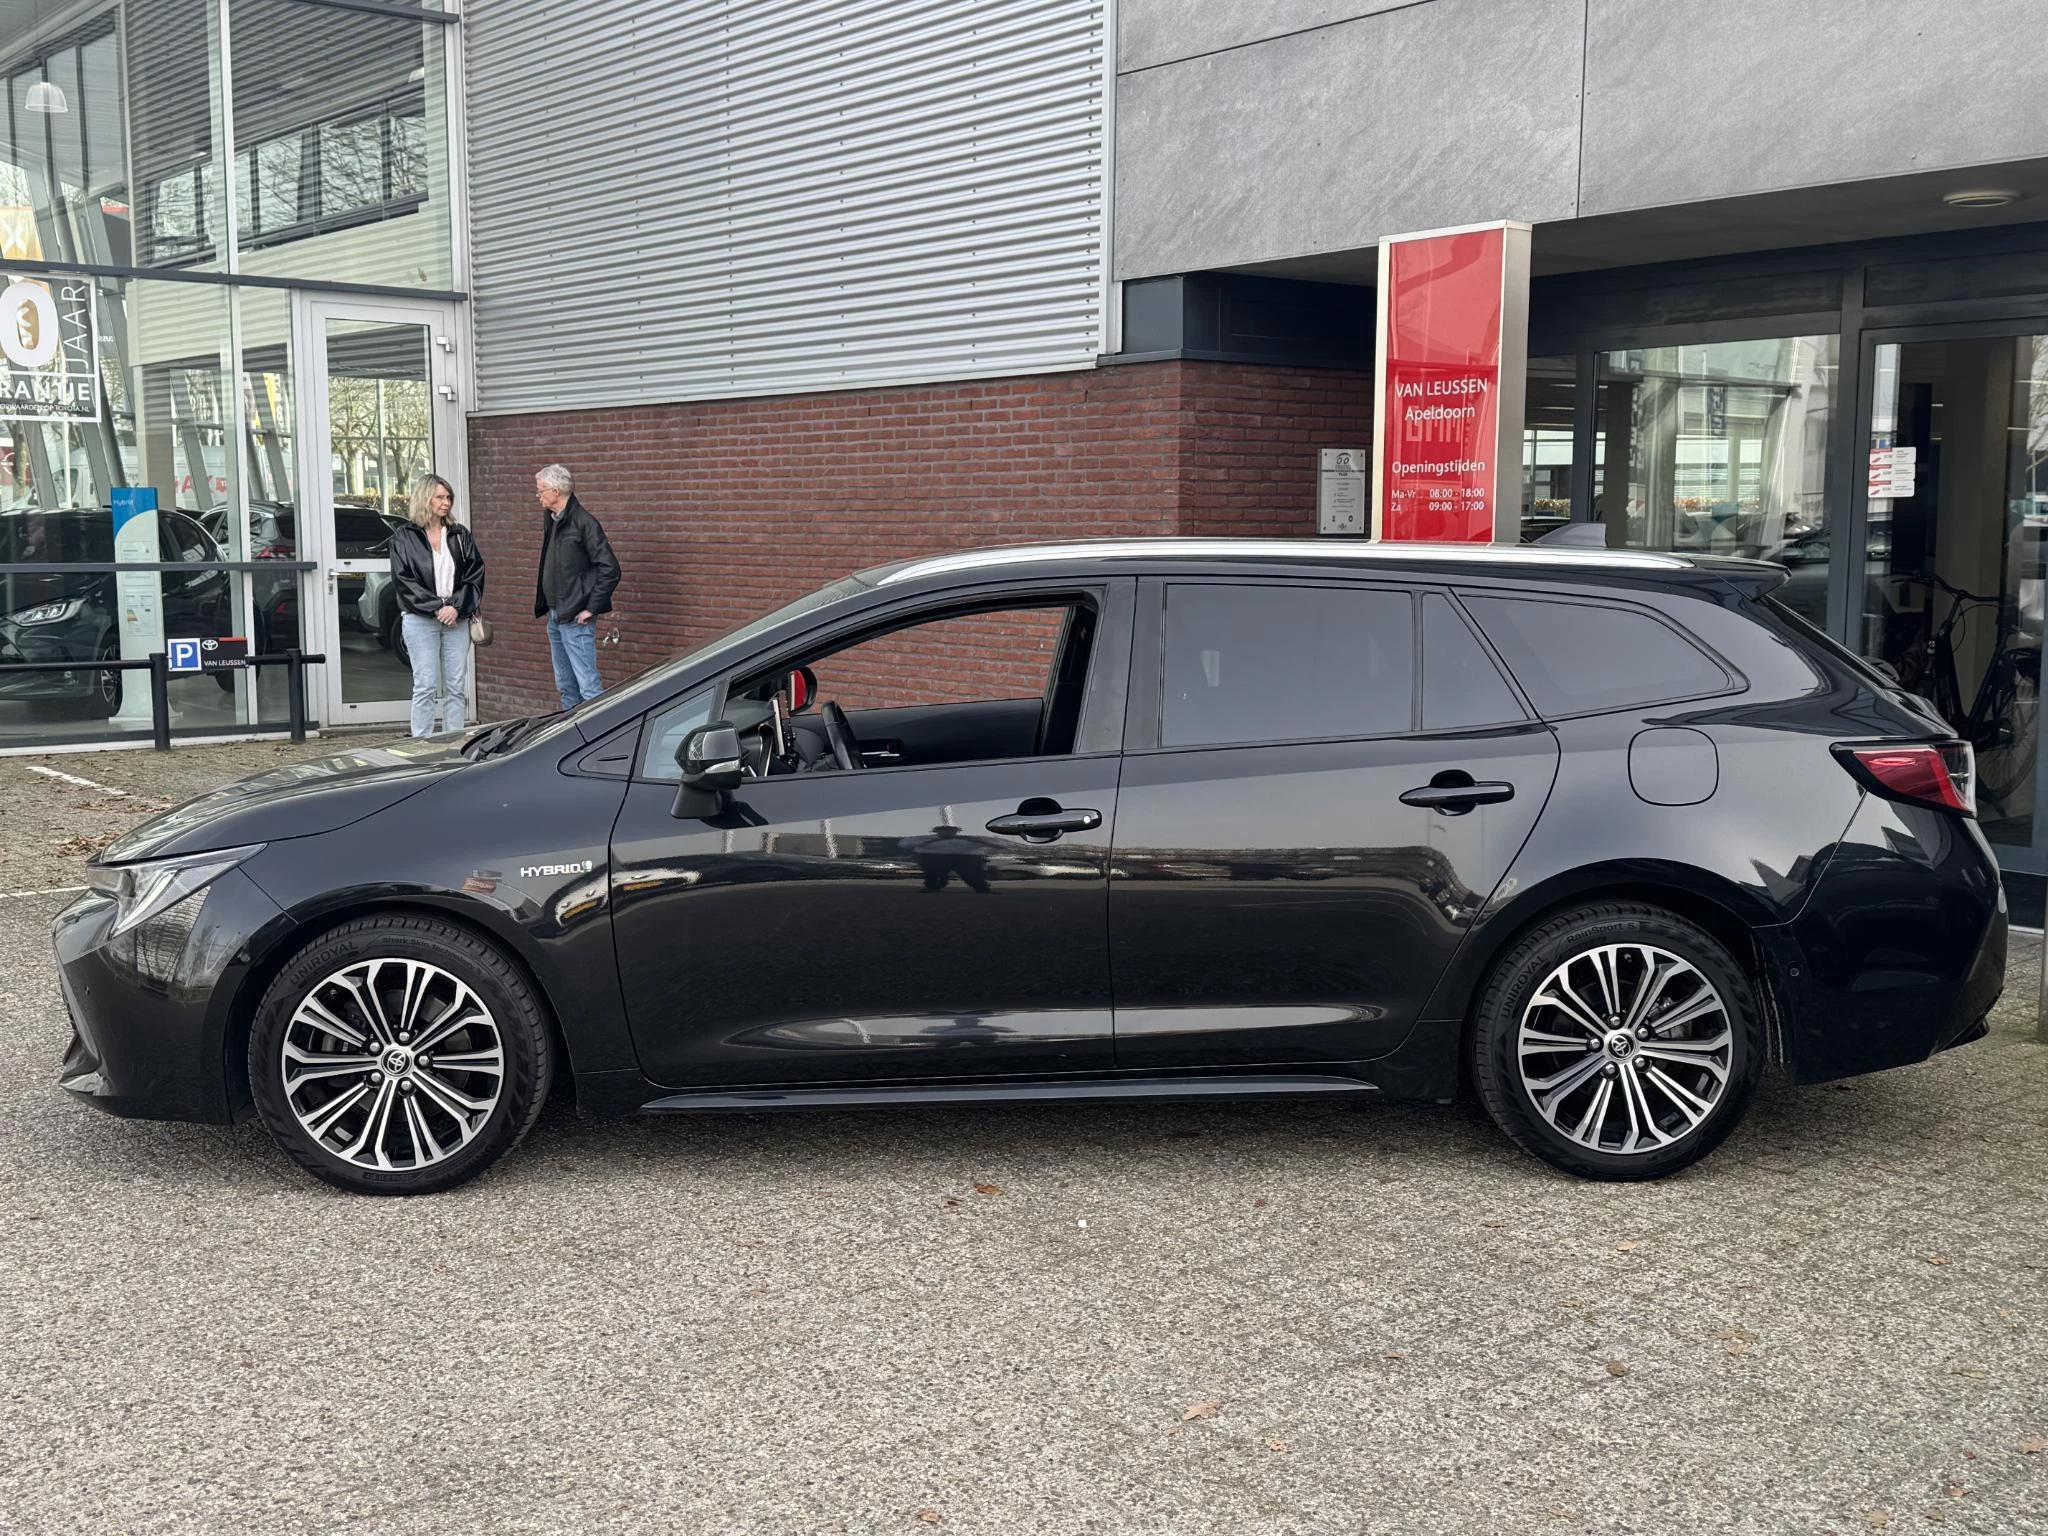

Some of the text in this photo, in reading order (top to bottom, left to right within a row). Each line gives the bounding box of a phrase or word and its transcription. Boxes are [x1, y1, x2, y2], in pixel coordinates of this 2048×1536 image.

[61, 285, 89, 374] JAAR
[1395, 378, 1488, 397] VAN LEUSSEN
[1405, 404, 1475, 425] Apeldoorn
[1392, 459, 1485, 477] Openingstijden
[1429, 488, 1453, 498] 08:00
[1461, 487, 1485, 498] 18:00
[1391, 502, 1401, 511] Za
[1429, 502, 1452, 511] 09:00
[1461, 501, 1484, 511] 17:00
[520, 863, 581, 878] HYBRID
[1567, 923, 1623, 943] RainSport
[289, 941, 358, 985] UNIROYAL
[1500, 955, 1548, 1018] UNIROYAL
